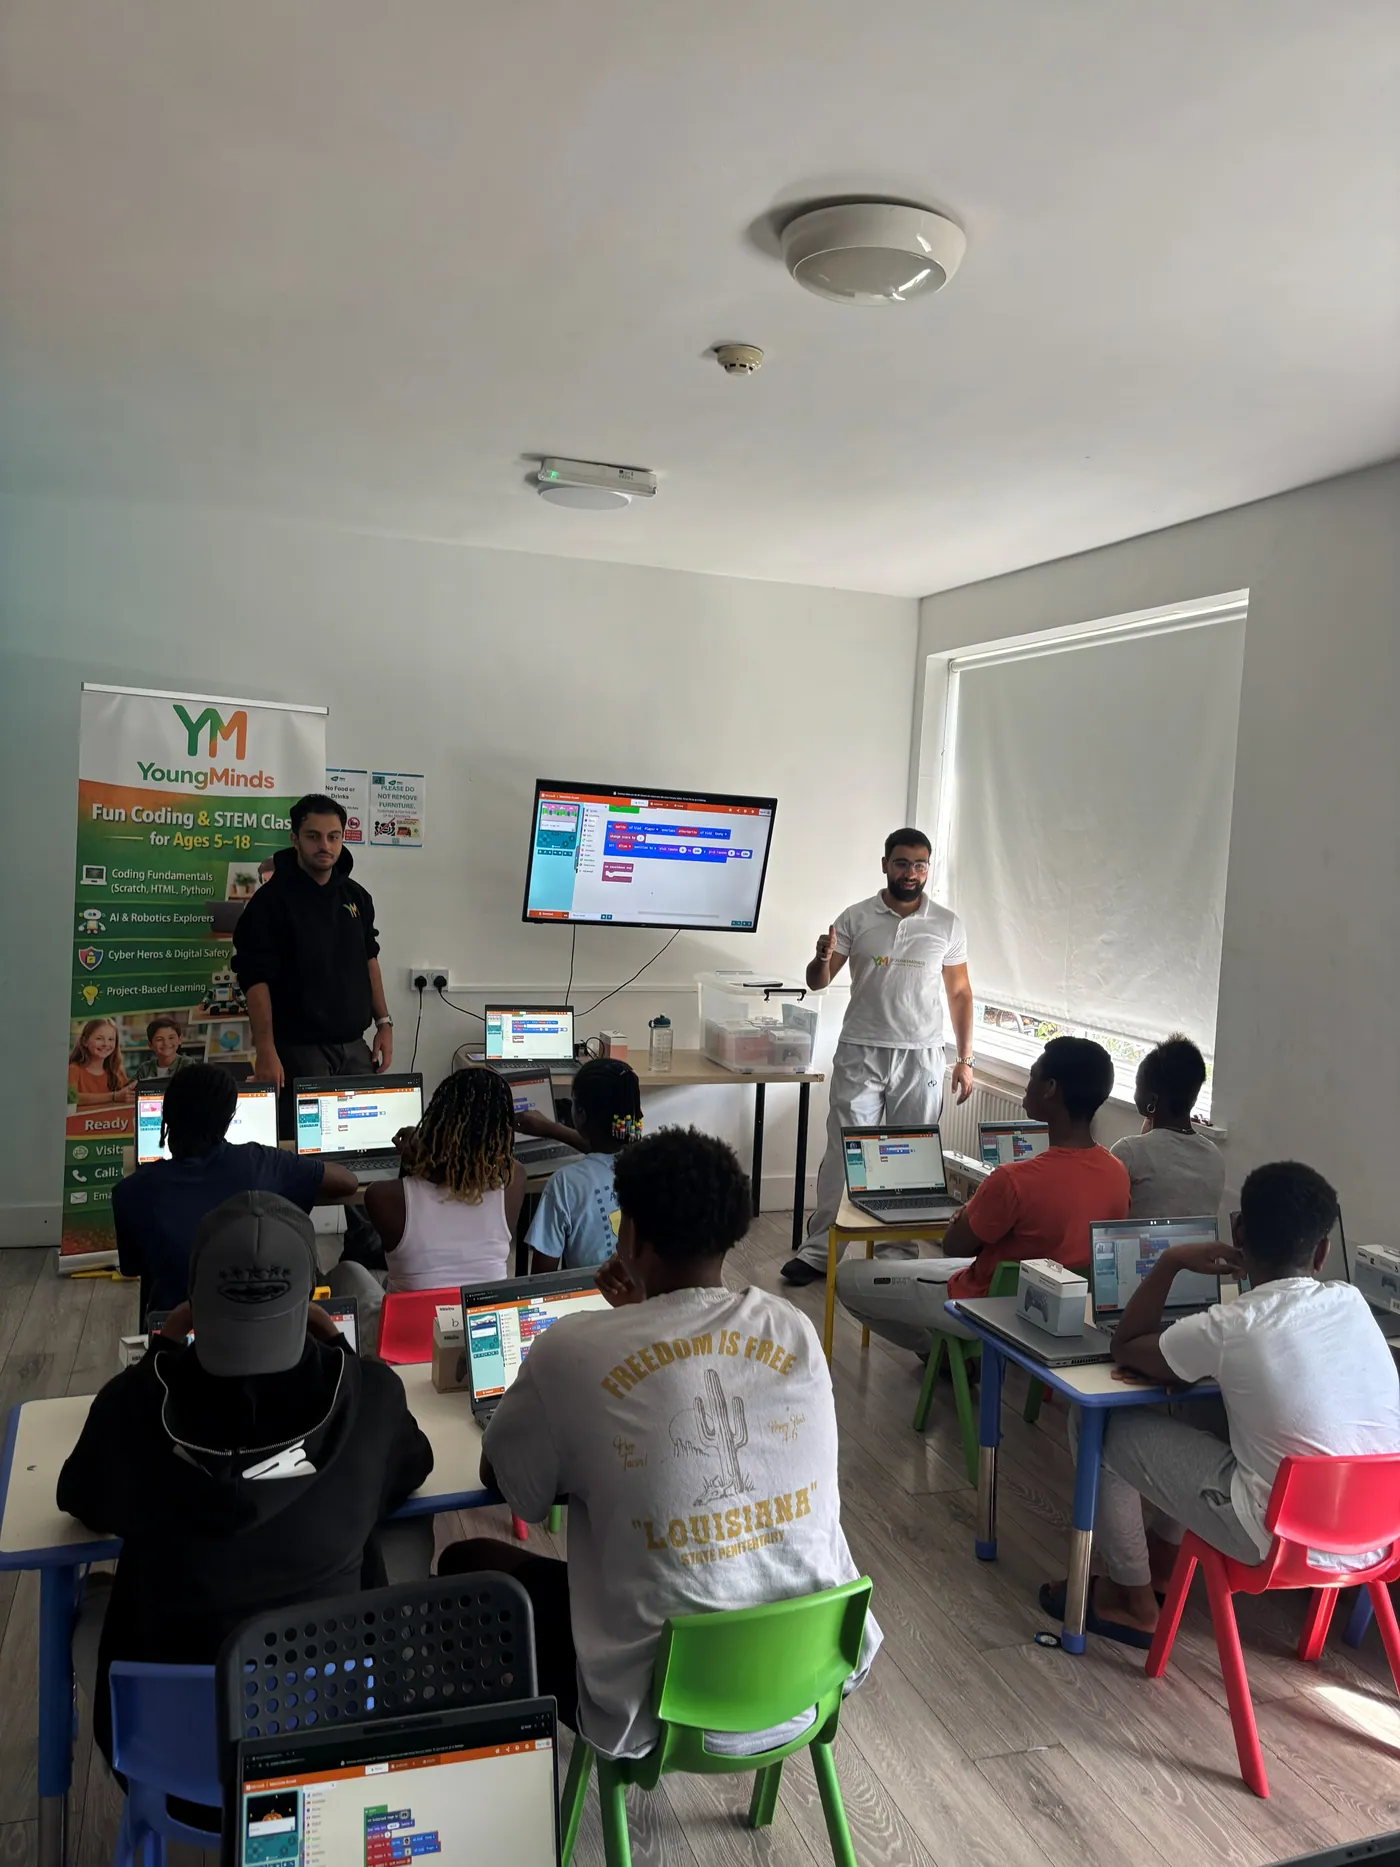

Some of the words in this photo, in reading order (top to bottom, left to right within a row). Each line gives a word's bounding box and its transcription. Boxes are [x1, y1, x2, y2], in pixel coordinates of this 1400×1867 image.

[172, 704, 248, 760] YM
[137, 761, 275, 790] YoungMinds
[92, 803, 126, 822] Fun
[131, 805, 194, 829] Coding
[197, 811, 210, 827] &
[214, 811, 257, 829] STEM
[149, 831, 170, 846] for
[173, 832, 210, 850] Ages
[111, 868, 145, 881] Coding
[147, 869, 213, 881] Fundamentals
[111, 883, 149, 895] (Scratch,
[151, 885, 179, 895] HTML,
[181, 885, 215, 897] Python)
[109, 913, 120, 923] AI
[122, 913, 129, 923] &
[131, 912, 171, 923] Robotics
[173, 913, 215, 925] Explorers
[108, 949, 135, 961] Cyber
[137, 949, 163, 959] Heros
[165, 949, 173, 958] &
[174, 948, 202, 959] Digital
[203, 948, 230, 959] Safety
[106, 984, 168, 996] Project-Based
[169, 983, 206, 993] Learning
[85, 1117, 129, 1131] Ready
[94, 1167, 119, 1178] Call:
[601, 1332, 713, 1400] FREEDOM
[717, 1329, 741, 1356] IS
[744, 1335, 797, 1376] FREE
